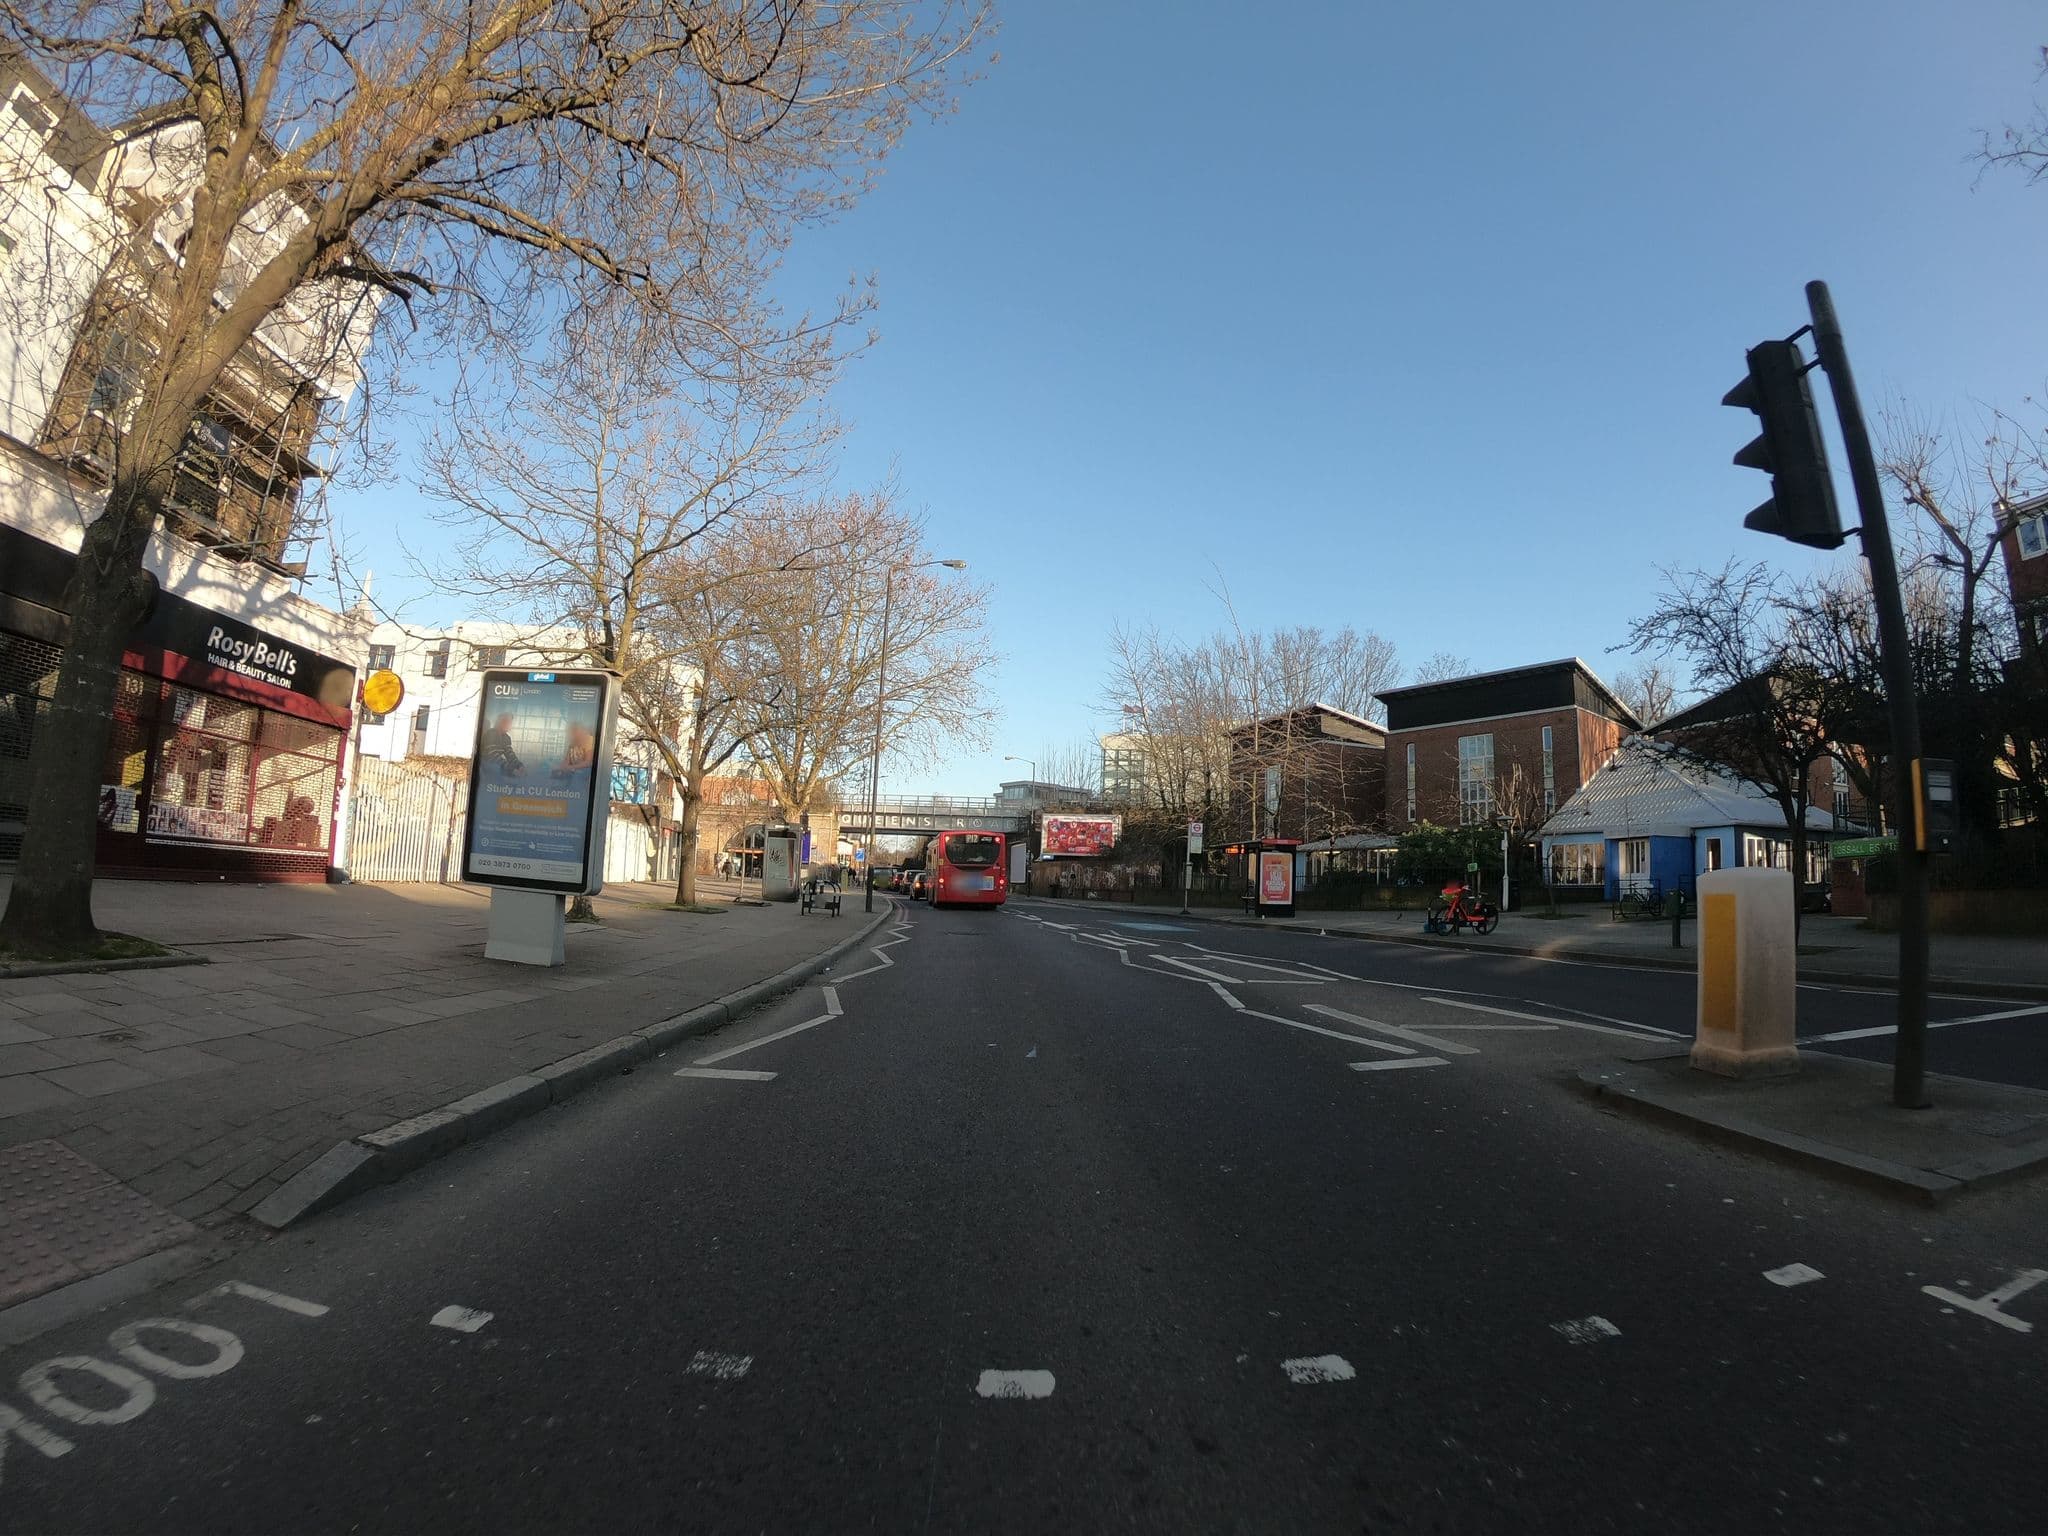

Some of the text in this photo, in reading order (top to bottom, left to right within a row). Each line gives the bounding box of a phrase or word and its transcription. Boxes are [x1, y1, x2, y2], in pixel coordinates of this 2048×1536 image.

[207, 653, 292, 689] HAIR & BEAUTY SALON
[486, 783, 581, 799] Study at CU London
[841, 813, 1019, 831] QUEENS ROAD
